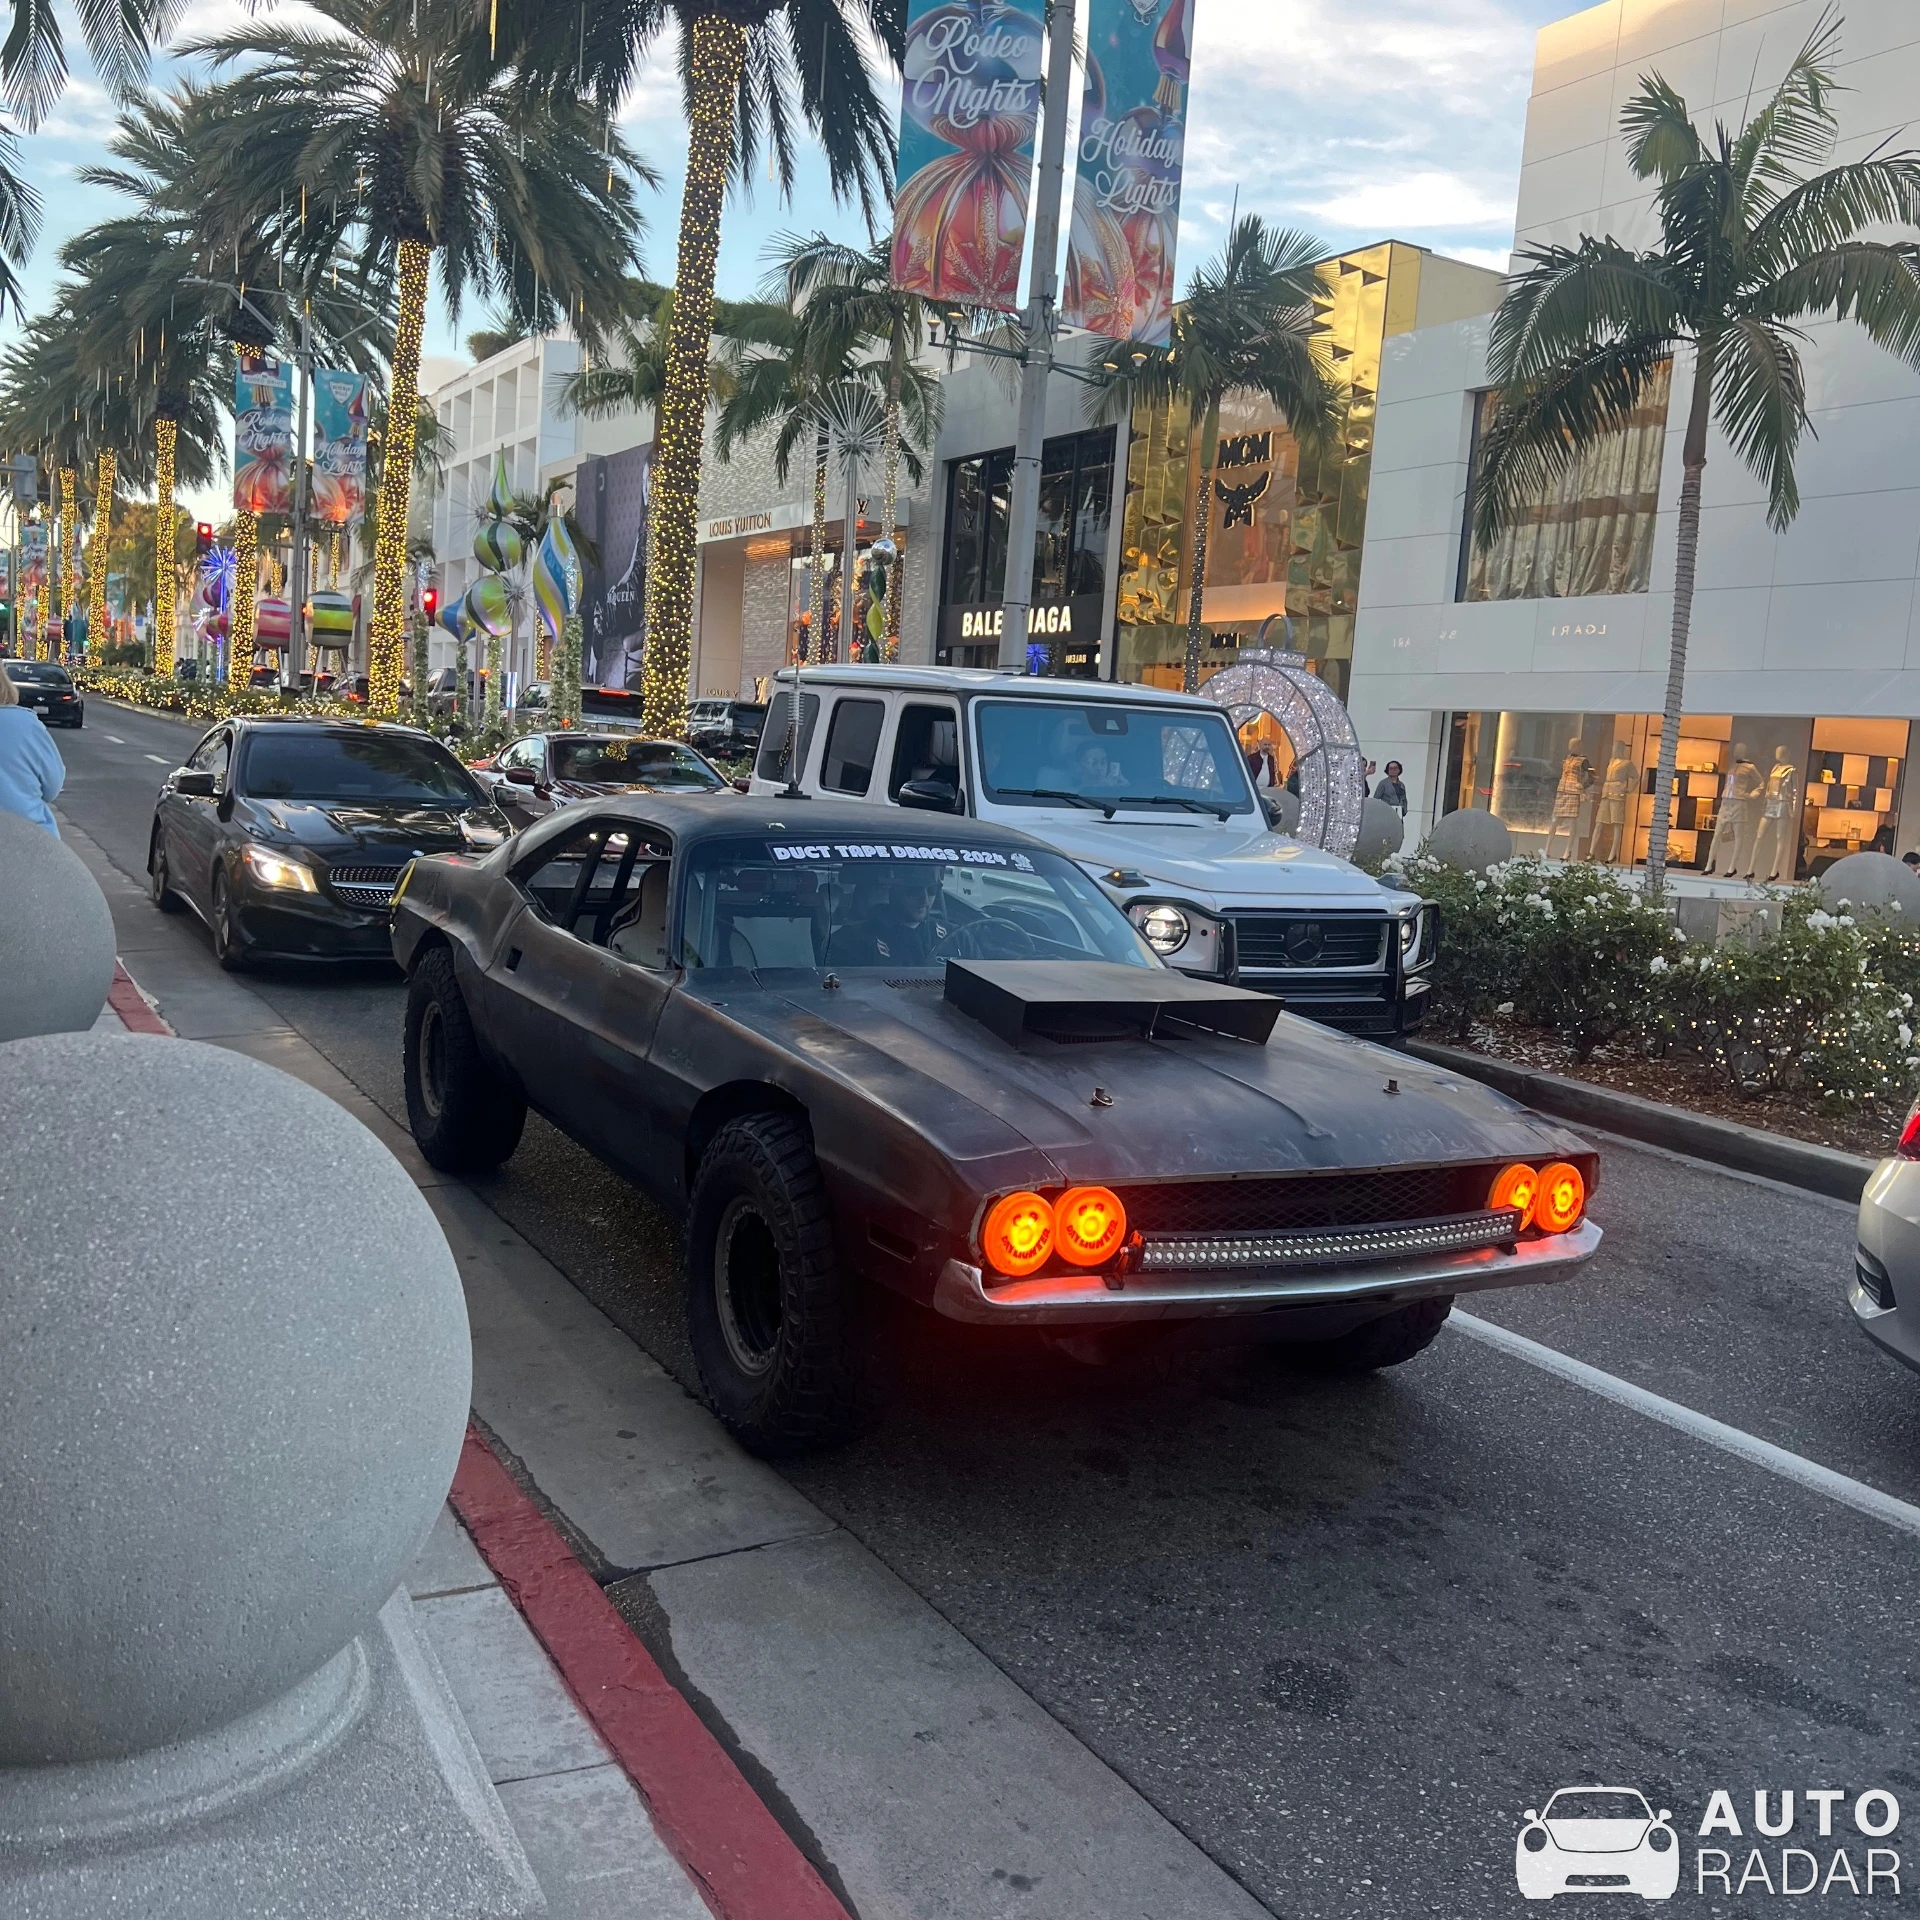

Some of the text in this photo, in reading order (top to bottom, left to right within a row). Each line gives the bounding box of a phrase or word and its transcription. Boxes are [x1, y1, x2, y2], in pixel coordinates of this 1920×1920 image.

[925, 15, 1032, 75] Rodeo
[912, 65, 1036, 129] Nights
[1080, 118, 1180, 172] Holiday
[1095, 167, 1180, 215] Lights
[243, 411, 287, 432] Rodeo
[239, 429, 290, 452] Nights
[314, 441, 367, 461] Holiday
[1216, 431, 1274, 470] MCM
[321, 459, 366, 477] Lights
[709, 511, 773, 538] LOUIS VUITTON
[961, 605, 1072, 638] BALEIAGA
[1210, 632, 1240, 649] MCM
[773, 844, 1007, 866] DUCT TAPE DRAGS 2024
